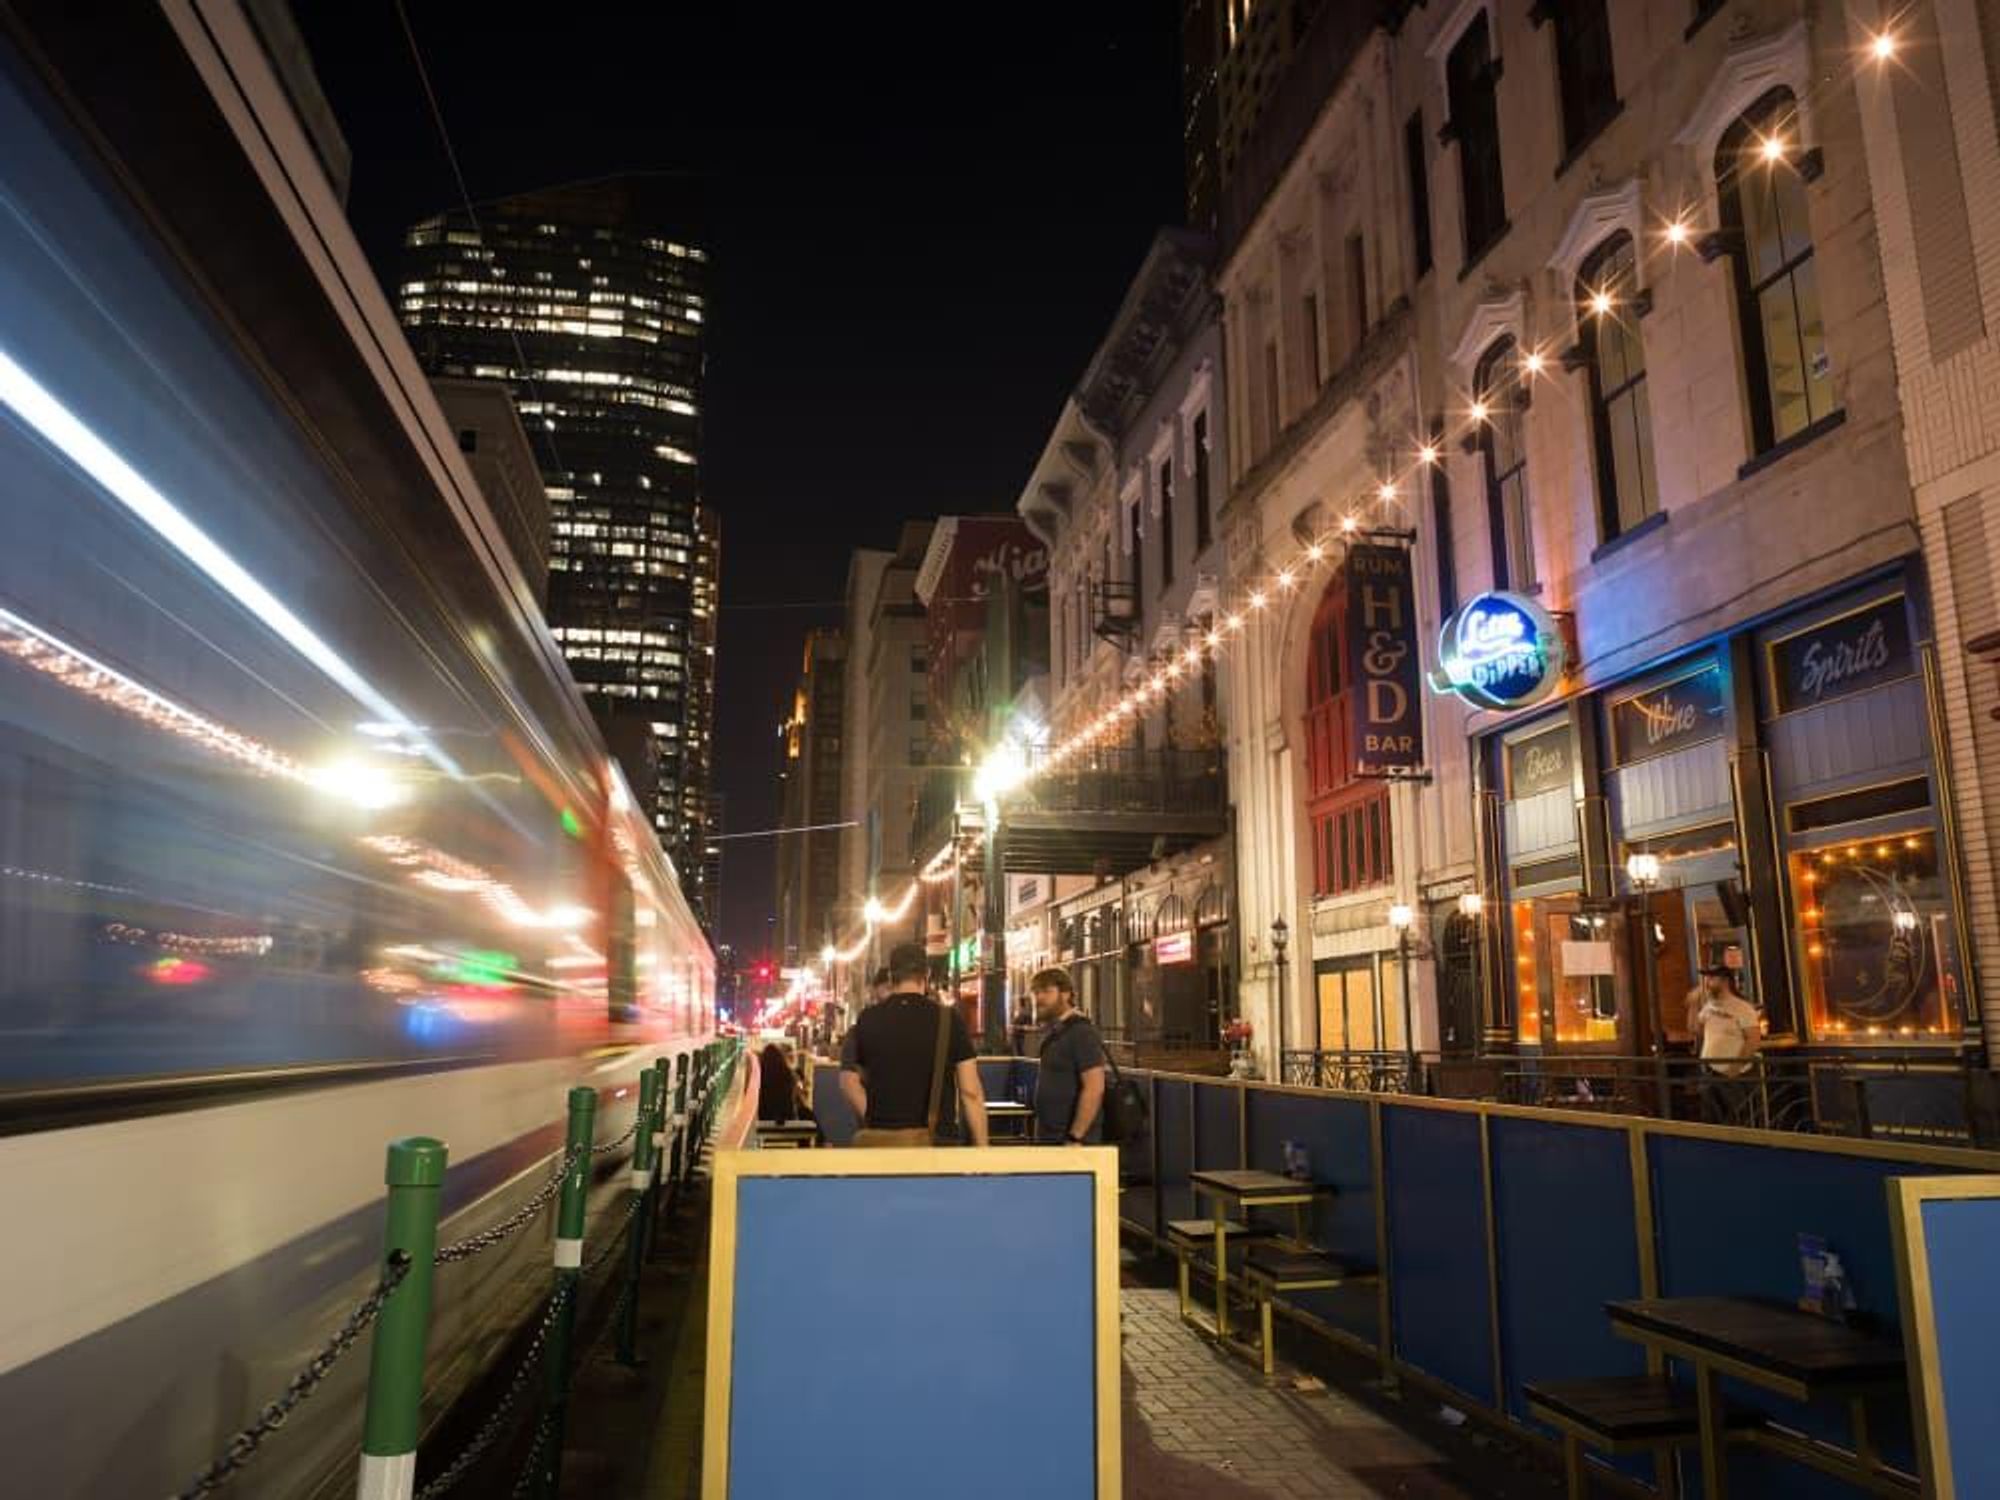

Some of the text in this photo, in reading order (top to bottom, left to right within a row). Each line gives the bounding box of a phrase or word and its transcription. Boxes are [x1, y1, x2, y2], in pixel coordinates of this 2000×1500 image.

[1353, 556, 1402, 576] RUM
[1362, 586, 1407, 723] H&D
[1801, 620, 1888, 697] Spirits
[1648, 695, 1696, 743] Wine
[1365, 735, 1413, 752] BAR
[1525, 747, 1562, 780] Beer
